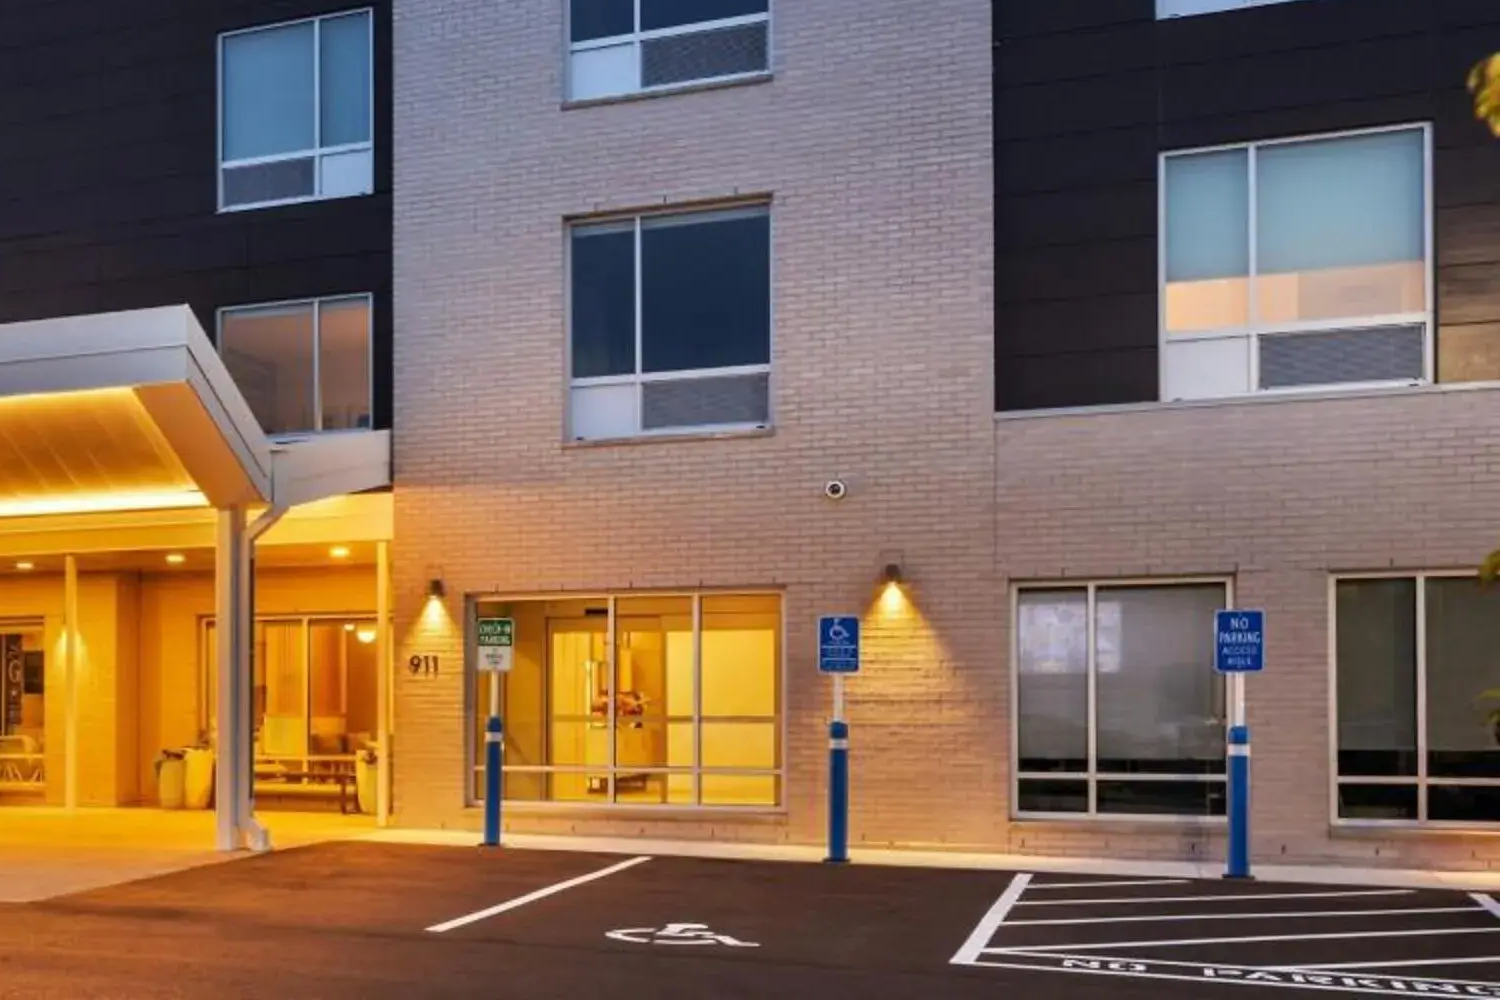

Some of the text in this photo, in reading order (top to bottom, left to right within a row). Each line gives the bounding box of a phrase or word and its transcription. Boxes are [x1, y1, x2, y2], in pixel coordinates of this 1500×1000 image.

[1230, 617, 1249, 630] NO
[1219, 631, 1261, 644] PARKING
[408, 654, 439, 679] 911
[1062, 959, 1500, 997] NO PARKING
